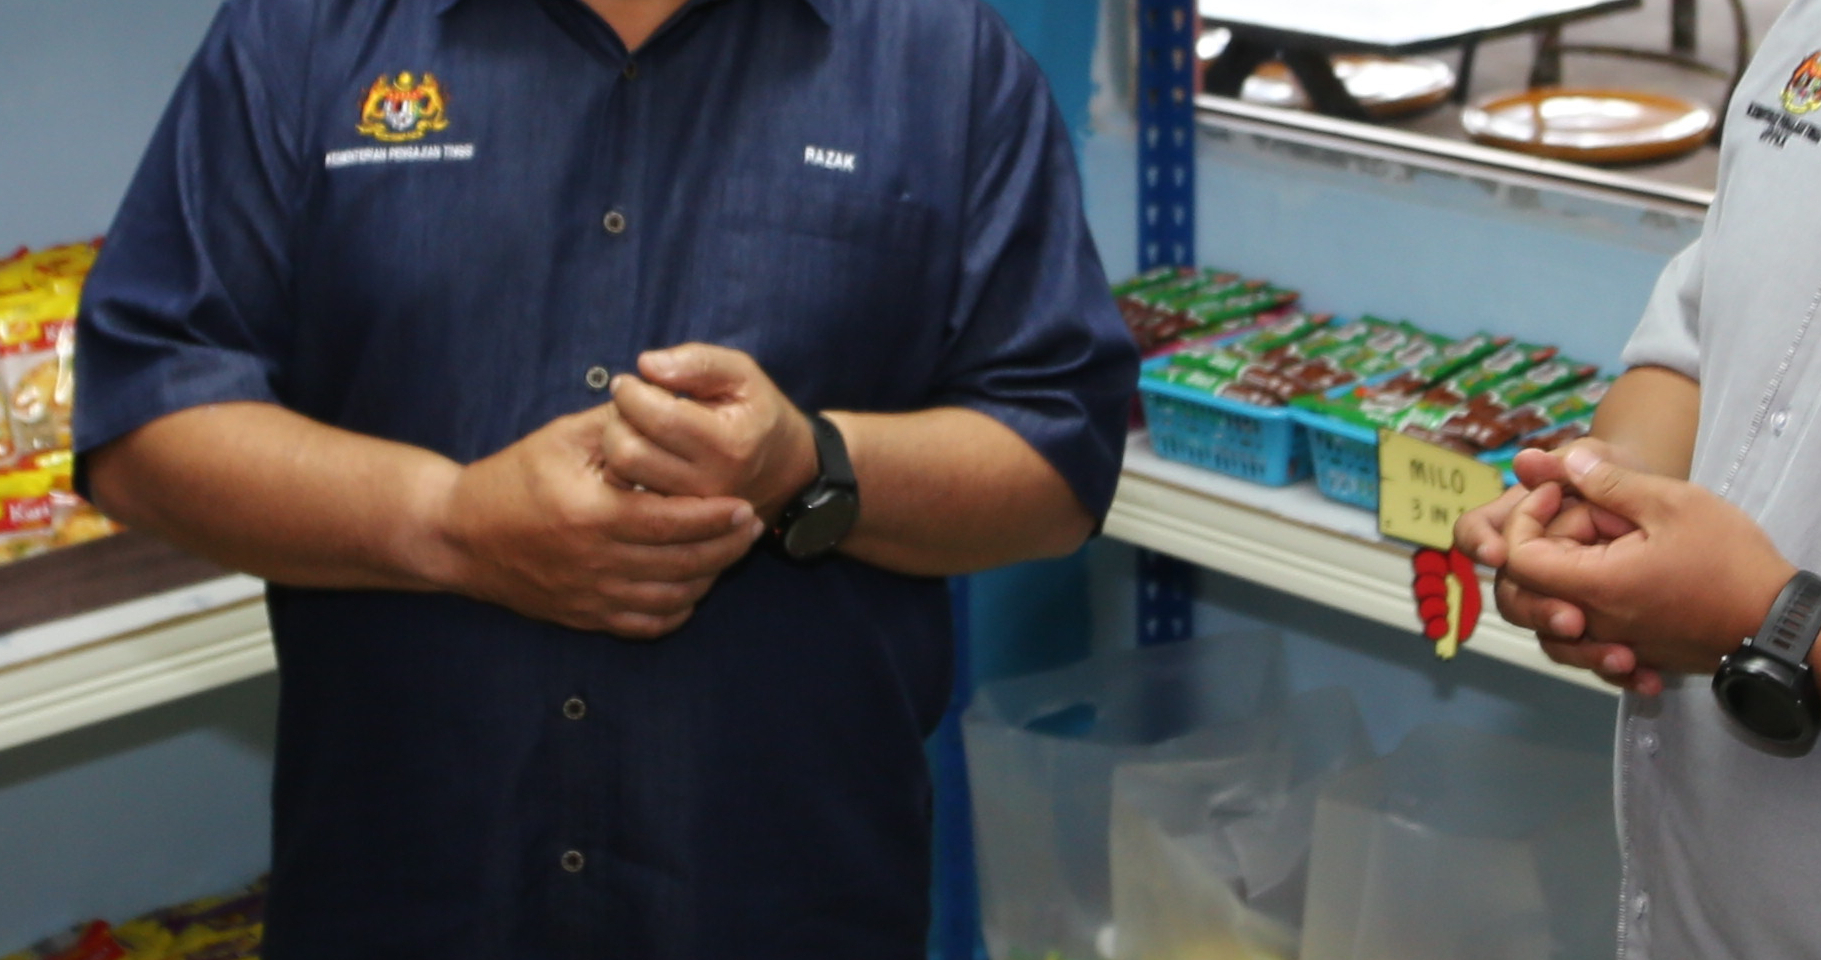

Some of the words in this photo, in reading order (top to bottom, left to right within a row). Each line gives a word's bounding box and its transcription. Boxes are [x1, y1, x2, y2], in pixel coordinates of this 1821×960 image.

[804, 146, 855, 172] RAZAK
[1410, 459, 1465, 494] MILO
[9, 501, 50, 522] Kari
[1412, 498, 1423, 520] 3
